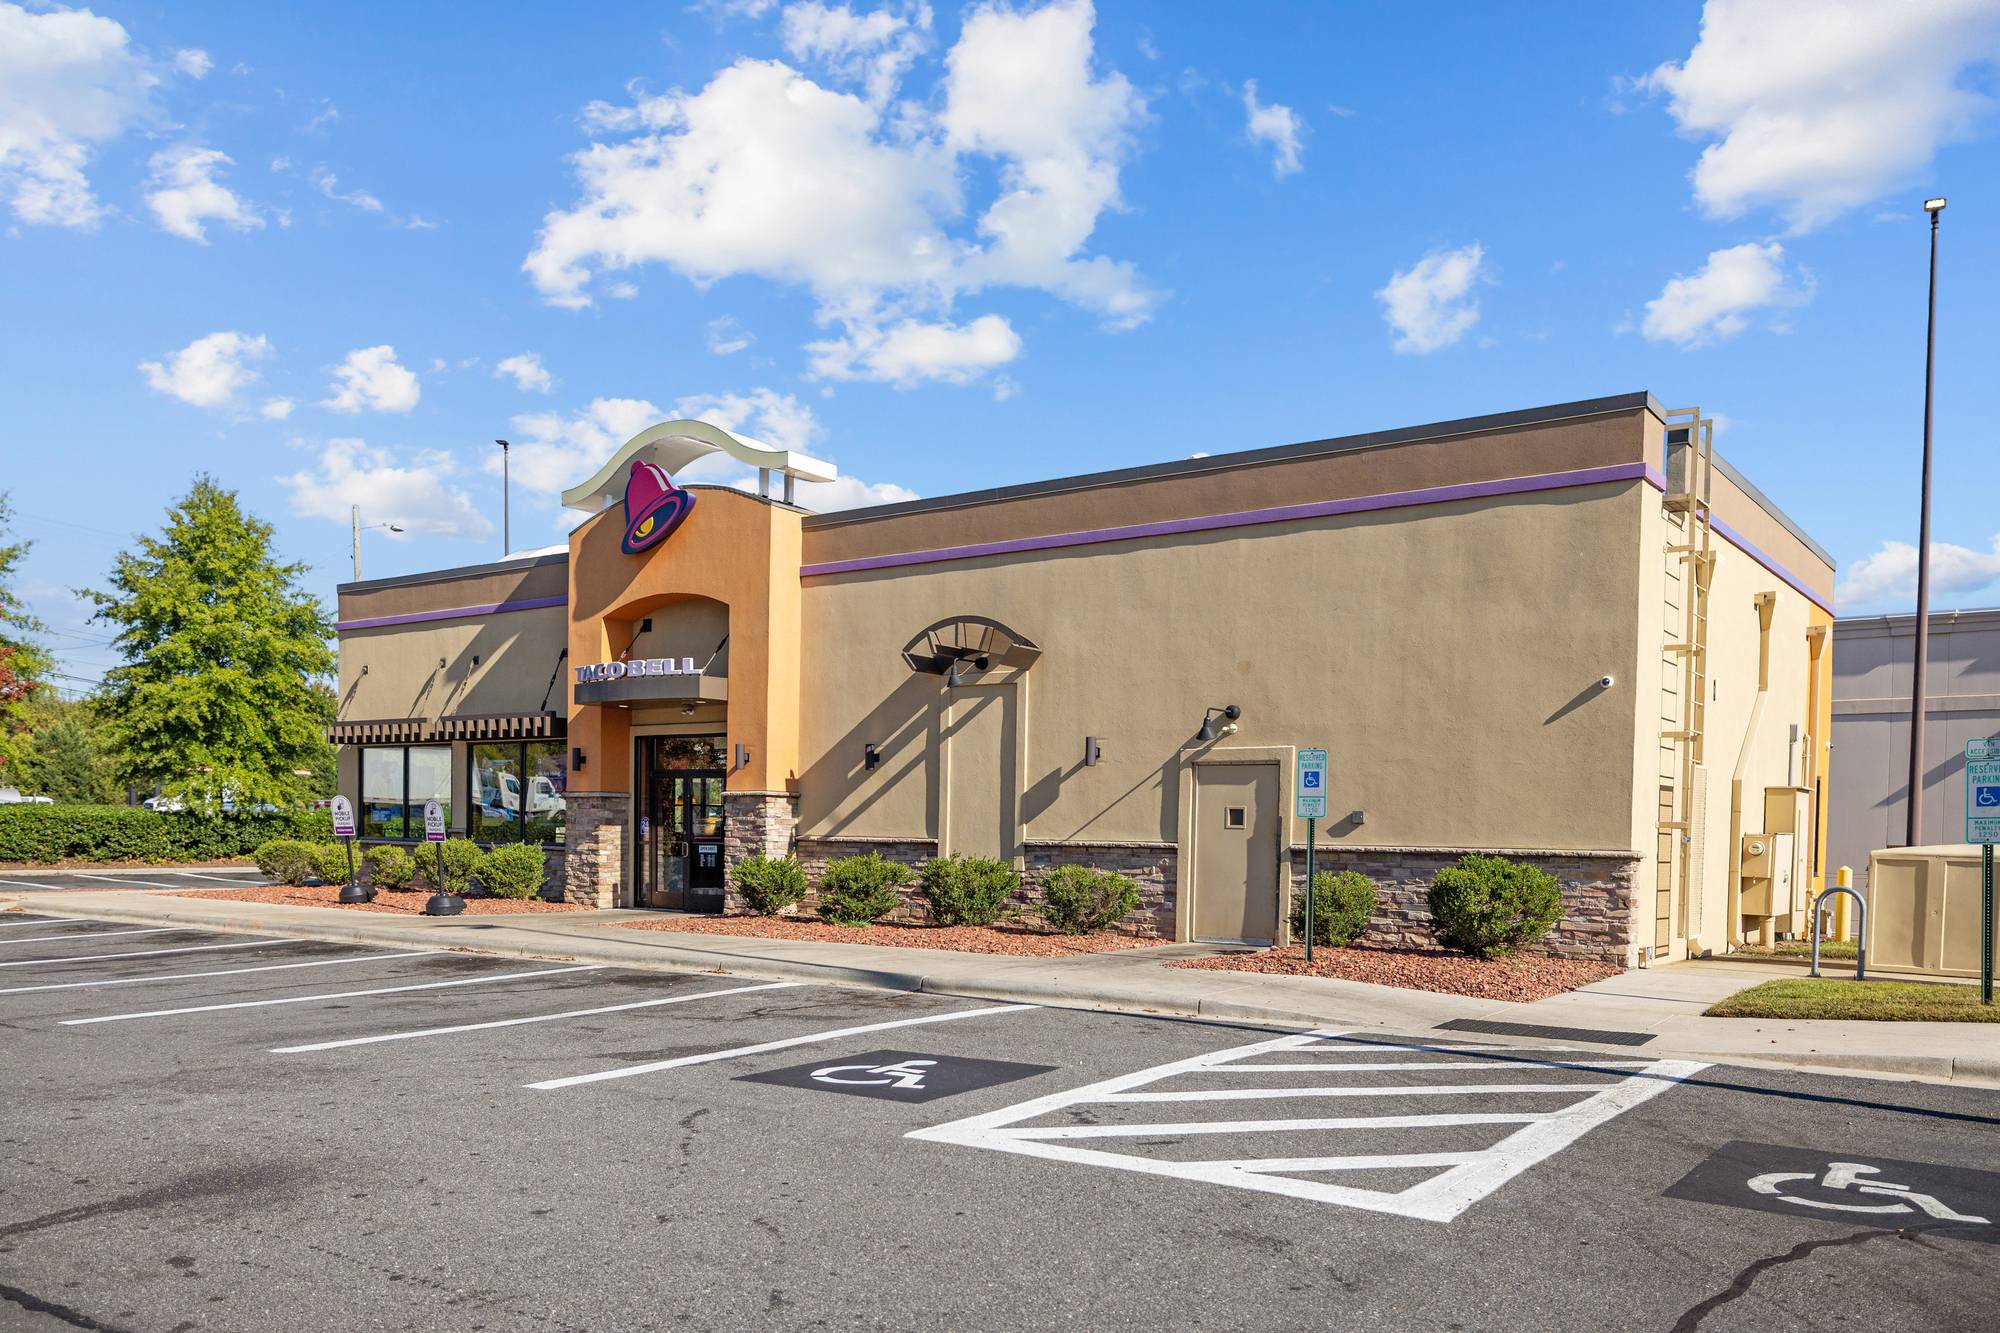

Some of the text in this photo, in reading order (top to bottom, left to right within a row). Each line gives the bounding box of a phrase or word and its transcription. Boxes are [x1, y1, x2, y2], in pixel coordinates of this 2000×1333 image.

[575, 657, 702, 681] TACO BELL
[1300, 753, 1325, 761] RESERVED
[1972, 775, 2000, 784] PARKIN
